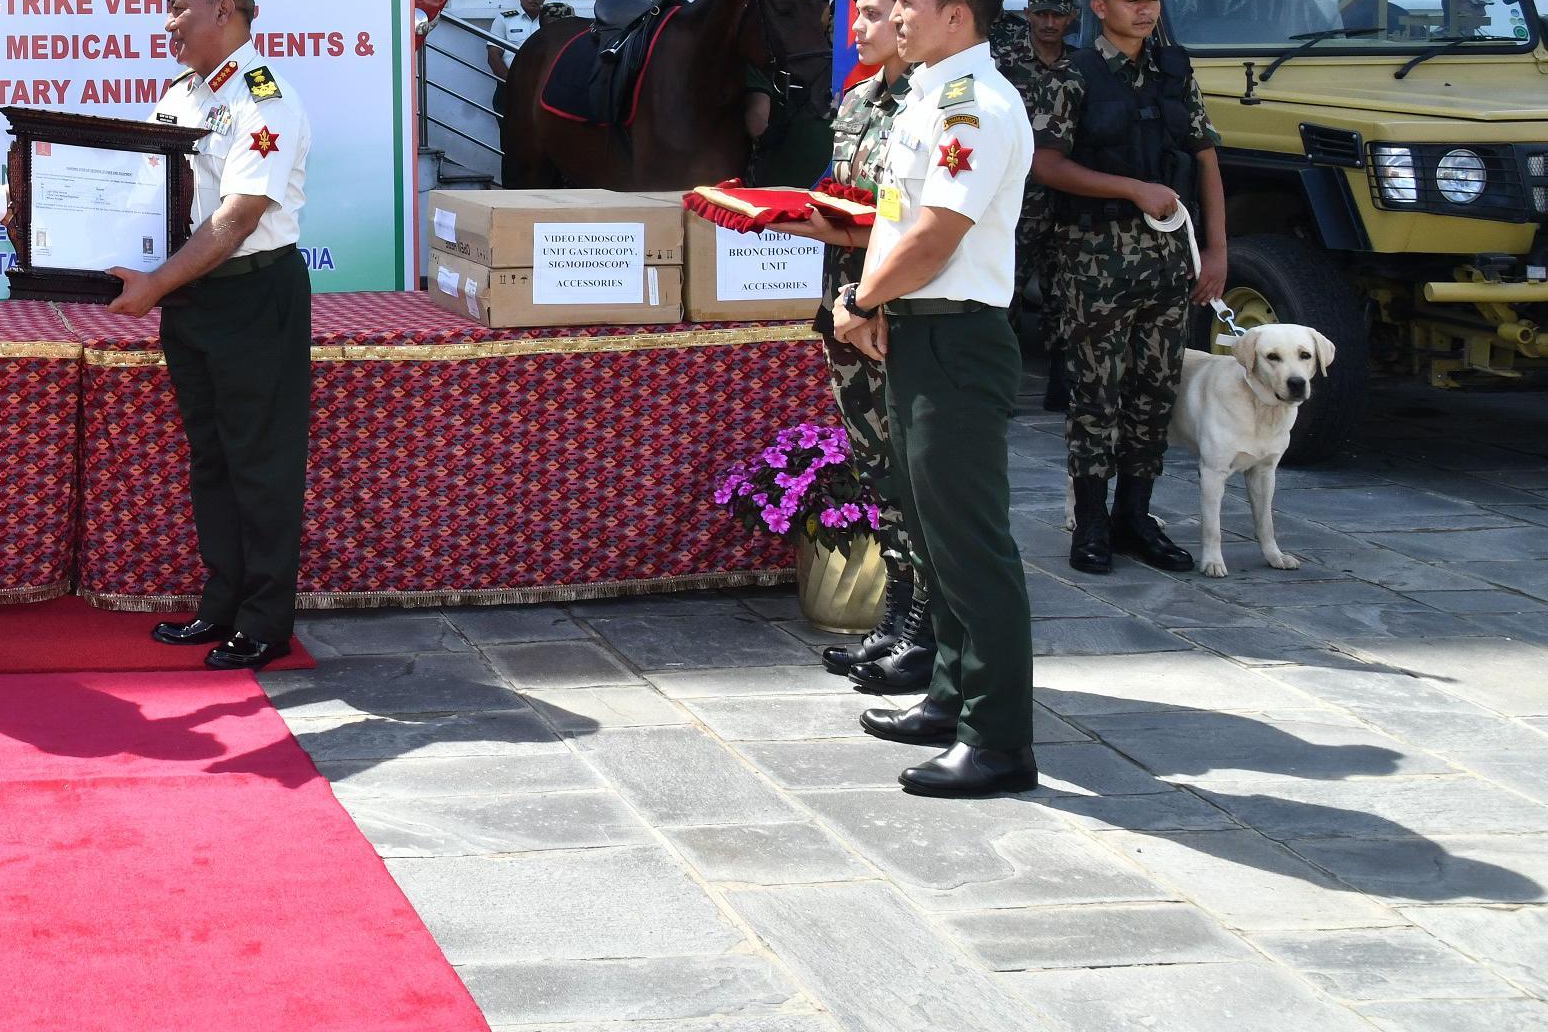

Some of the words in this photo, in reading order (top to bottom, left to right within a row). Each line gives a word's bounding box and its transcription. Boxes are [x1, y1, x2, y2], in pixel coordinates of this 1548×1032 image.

[6, 34, 140, 60] MEDICAL
[355, 31, 375, 57] &
[544, 234, 575, 243] VIDEO
[578, 234, 636, 243] ENDOSCOPY
[757, 232, 792, 242] VIDEO
[543, 247, 567, 256] UNIT
[569, 247, 638, 257] GASTROCOPY,
[729, 246, 820, 257] BRONCHOSCOPE
[548, 260, 630, 269] SIGMOIDOSCOPY
[761, 261, 788, 271] UNIT
[556, 279, 623, 288] ACCESSORIES
[741, 281, 808, 291] ACCESSORIES
